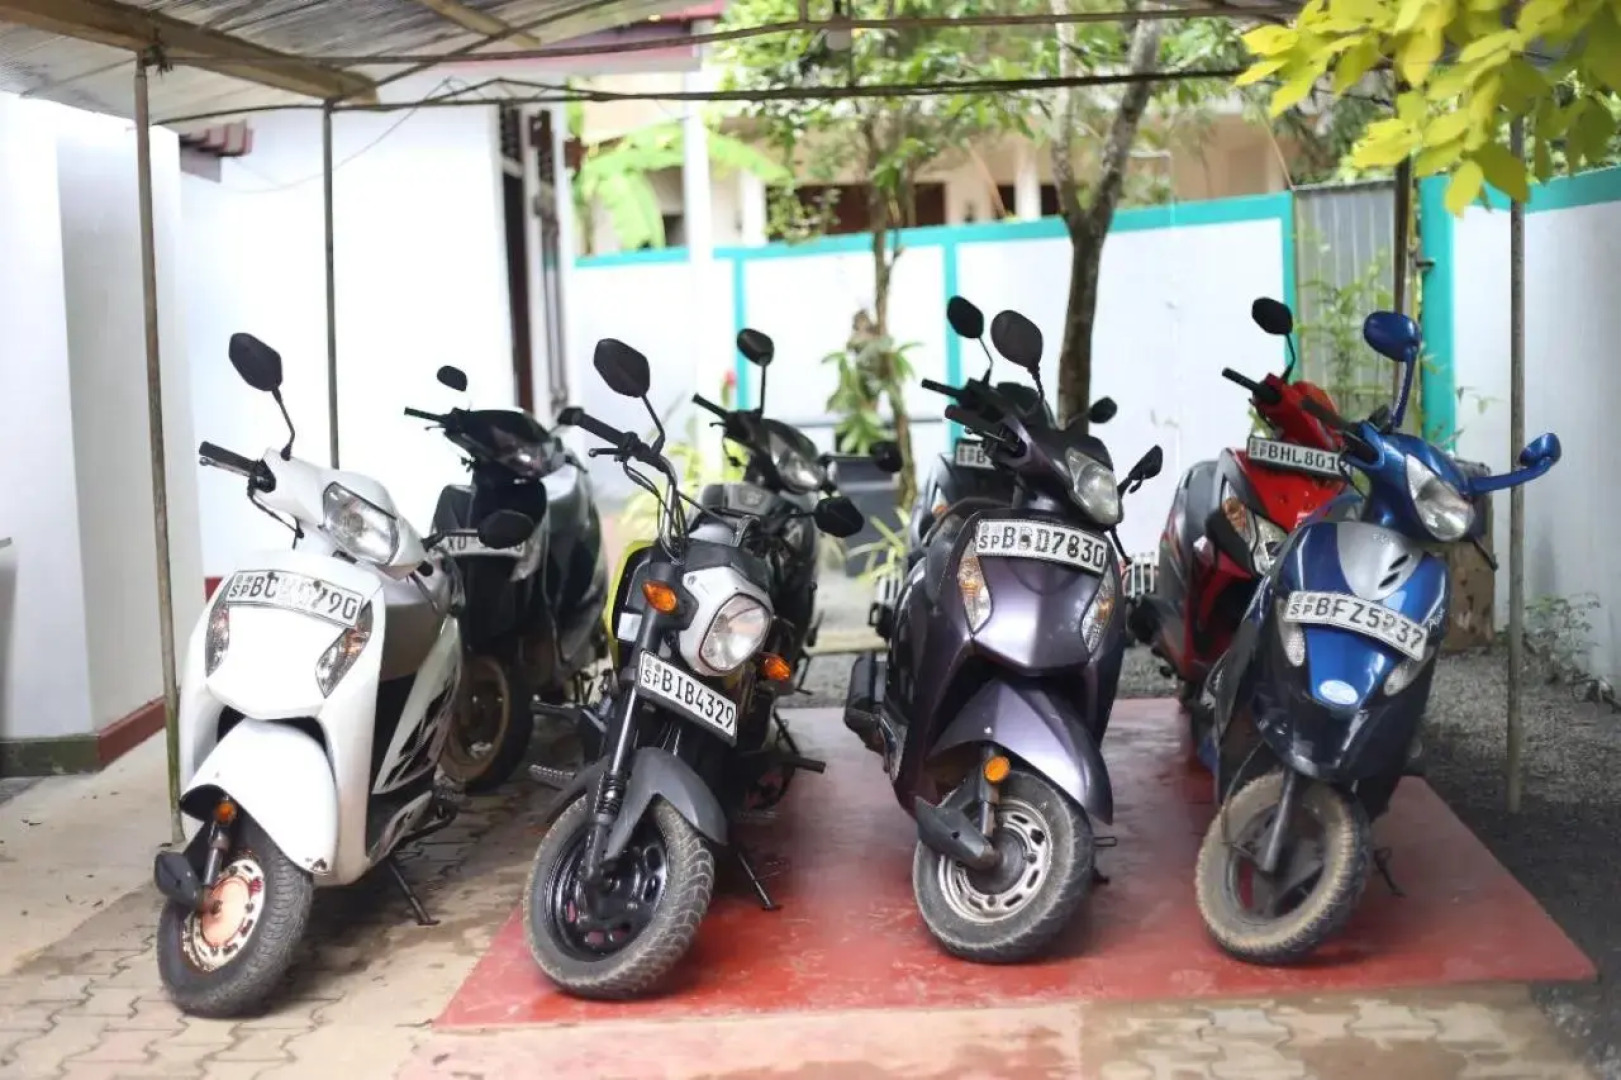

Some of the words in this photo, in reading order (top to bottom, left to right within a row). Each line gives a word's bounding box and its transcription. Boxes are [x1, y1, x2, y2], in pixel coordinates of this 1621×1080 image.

[1269, 444, 1337, 470] BHL801
[979, 535, 1000, 549] SP
[1290, 603, 1313, 615] SP
[661, 668, 734, 728] BIB4329
